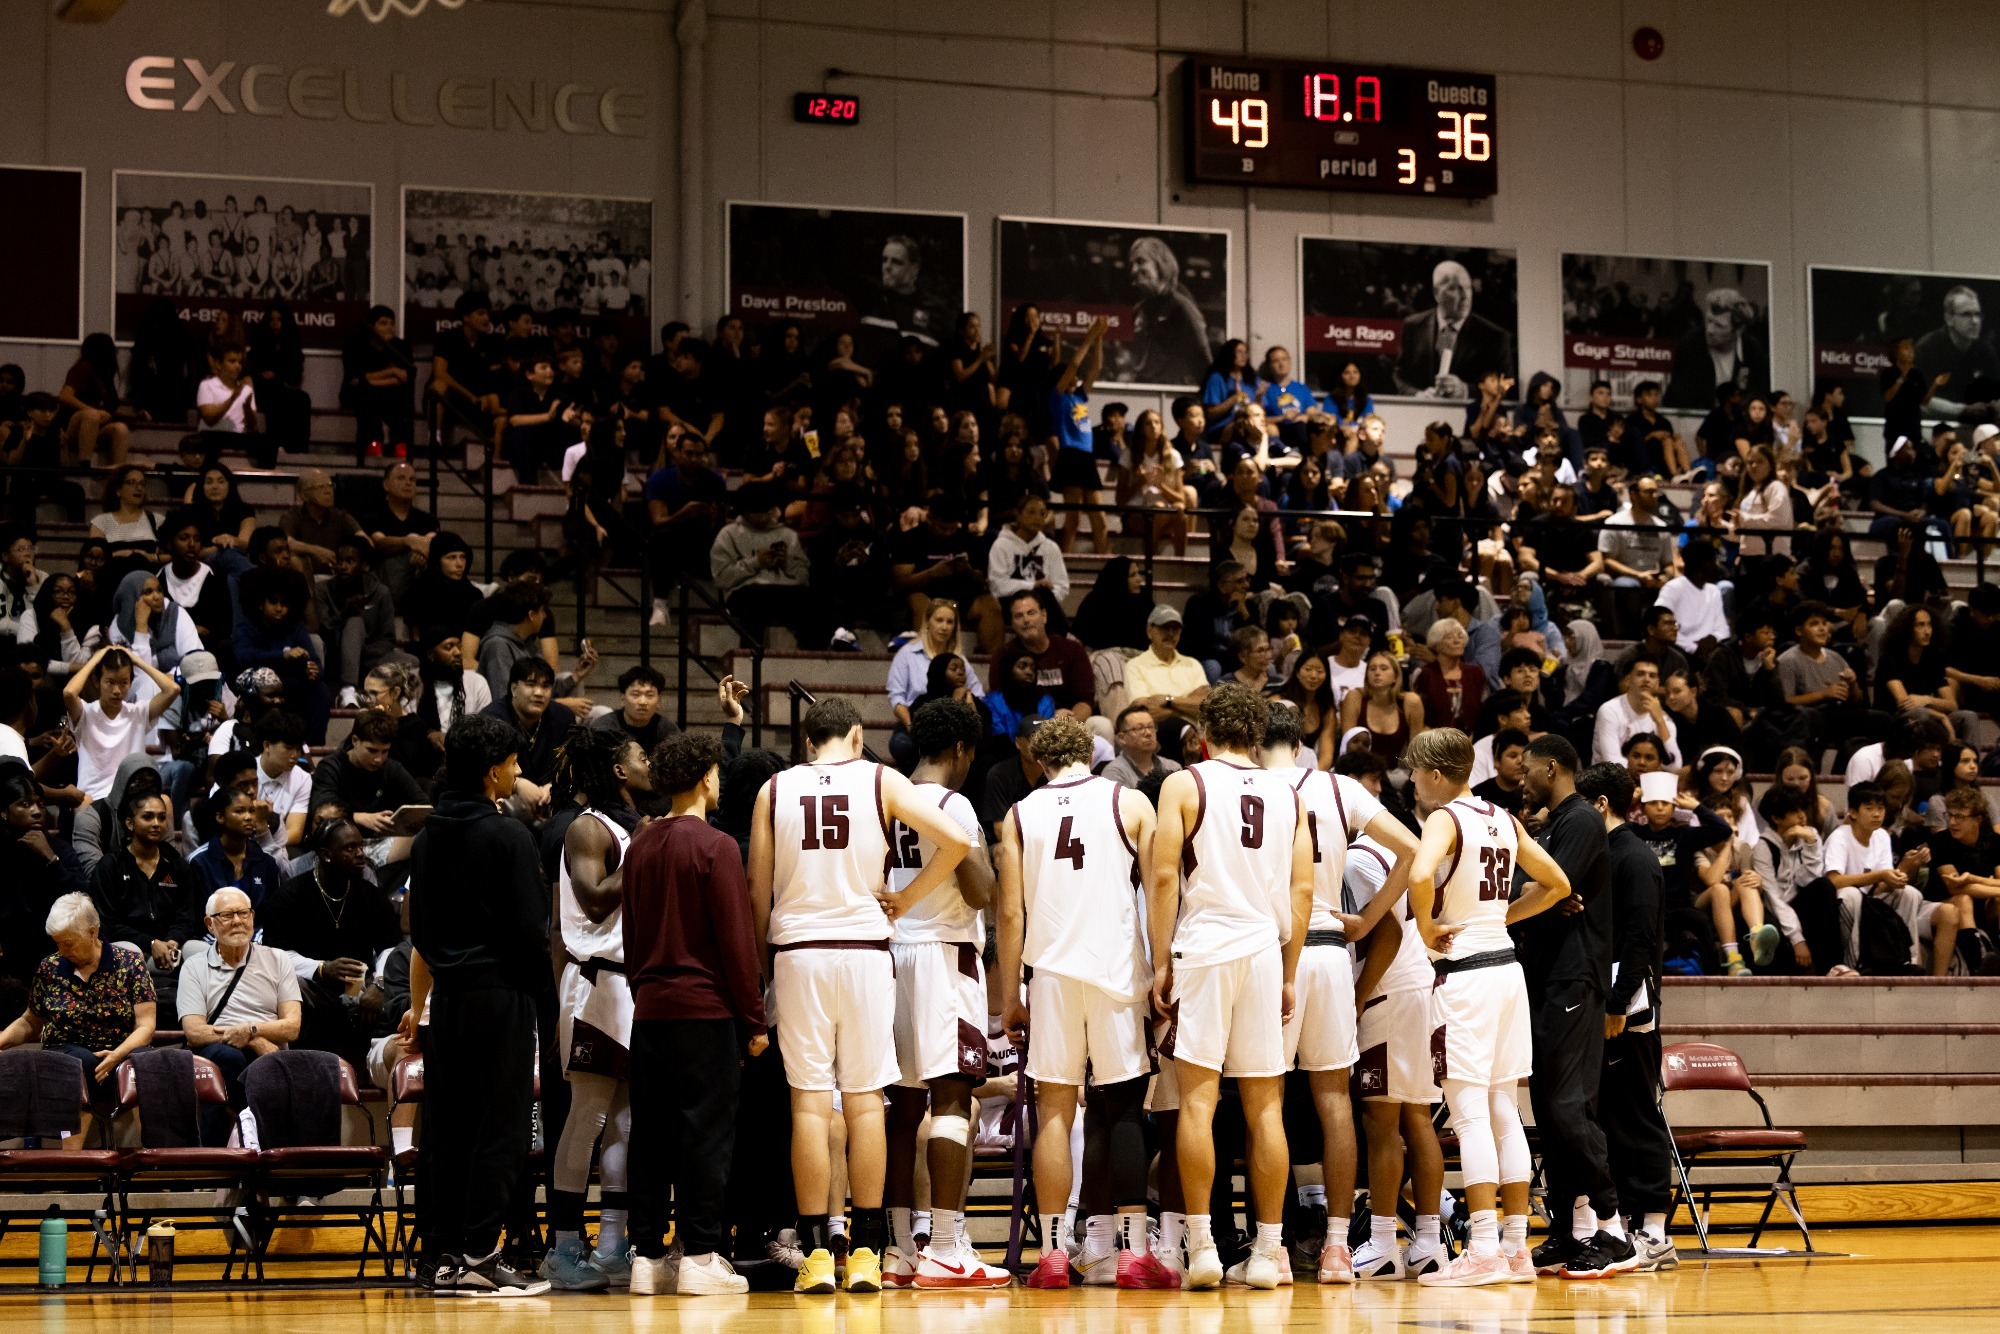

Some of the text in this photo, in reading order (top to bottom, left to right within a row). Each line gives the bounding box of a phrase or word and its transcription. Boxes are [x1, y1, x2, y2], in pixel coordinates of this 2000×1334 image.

[1210, 66, 1260, 92] Home
[1427, 79, 1489, 107] Guests
[125, 54, 649, 138] EXCELLENCE
[807, 98, 857, 120] 12:20
[1211, 98, 1269, 149] 49
[1437, 110, 1491, 162] 36
[1320, 157, 1378, 180] period
[1397, 147, 1417, 185] 3
[741, 293, 847, 313] Dave Preston
[1323, 323, 1396, 342] Joe Raso
[1573, 342, 1672, 361] Gaye Stratten
[1820, 349, 1852, 365] Nick
[800, 794, 850, 850] 15
[1240, 795, 1264, 850] 9
[1054, 815, 1085, 870] 4
[1479, 846, 1511, 901] 32
